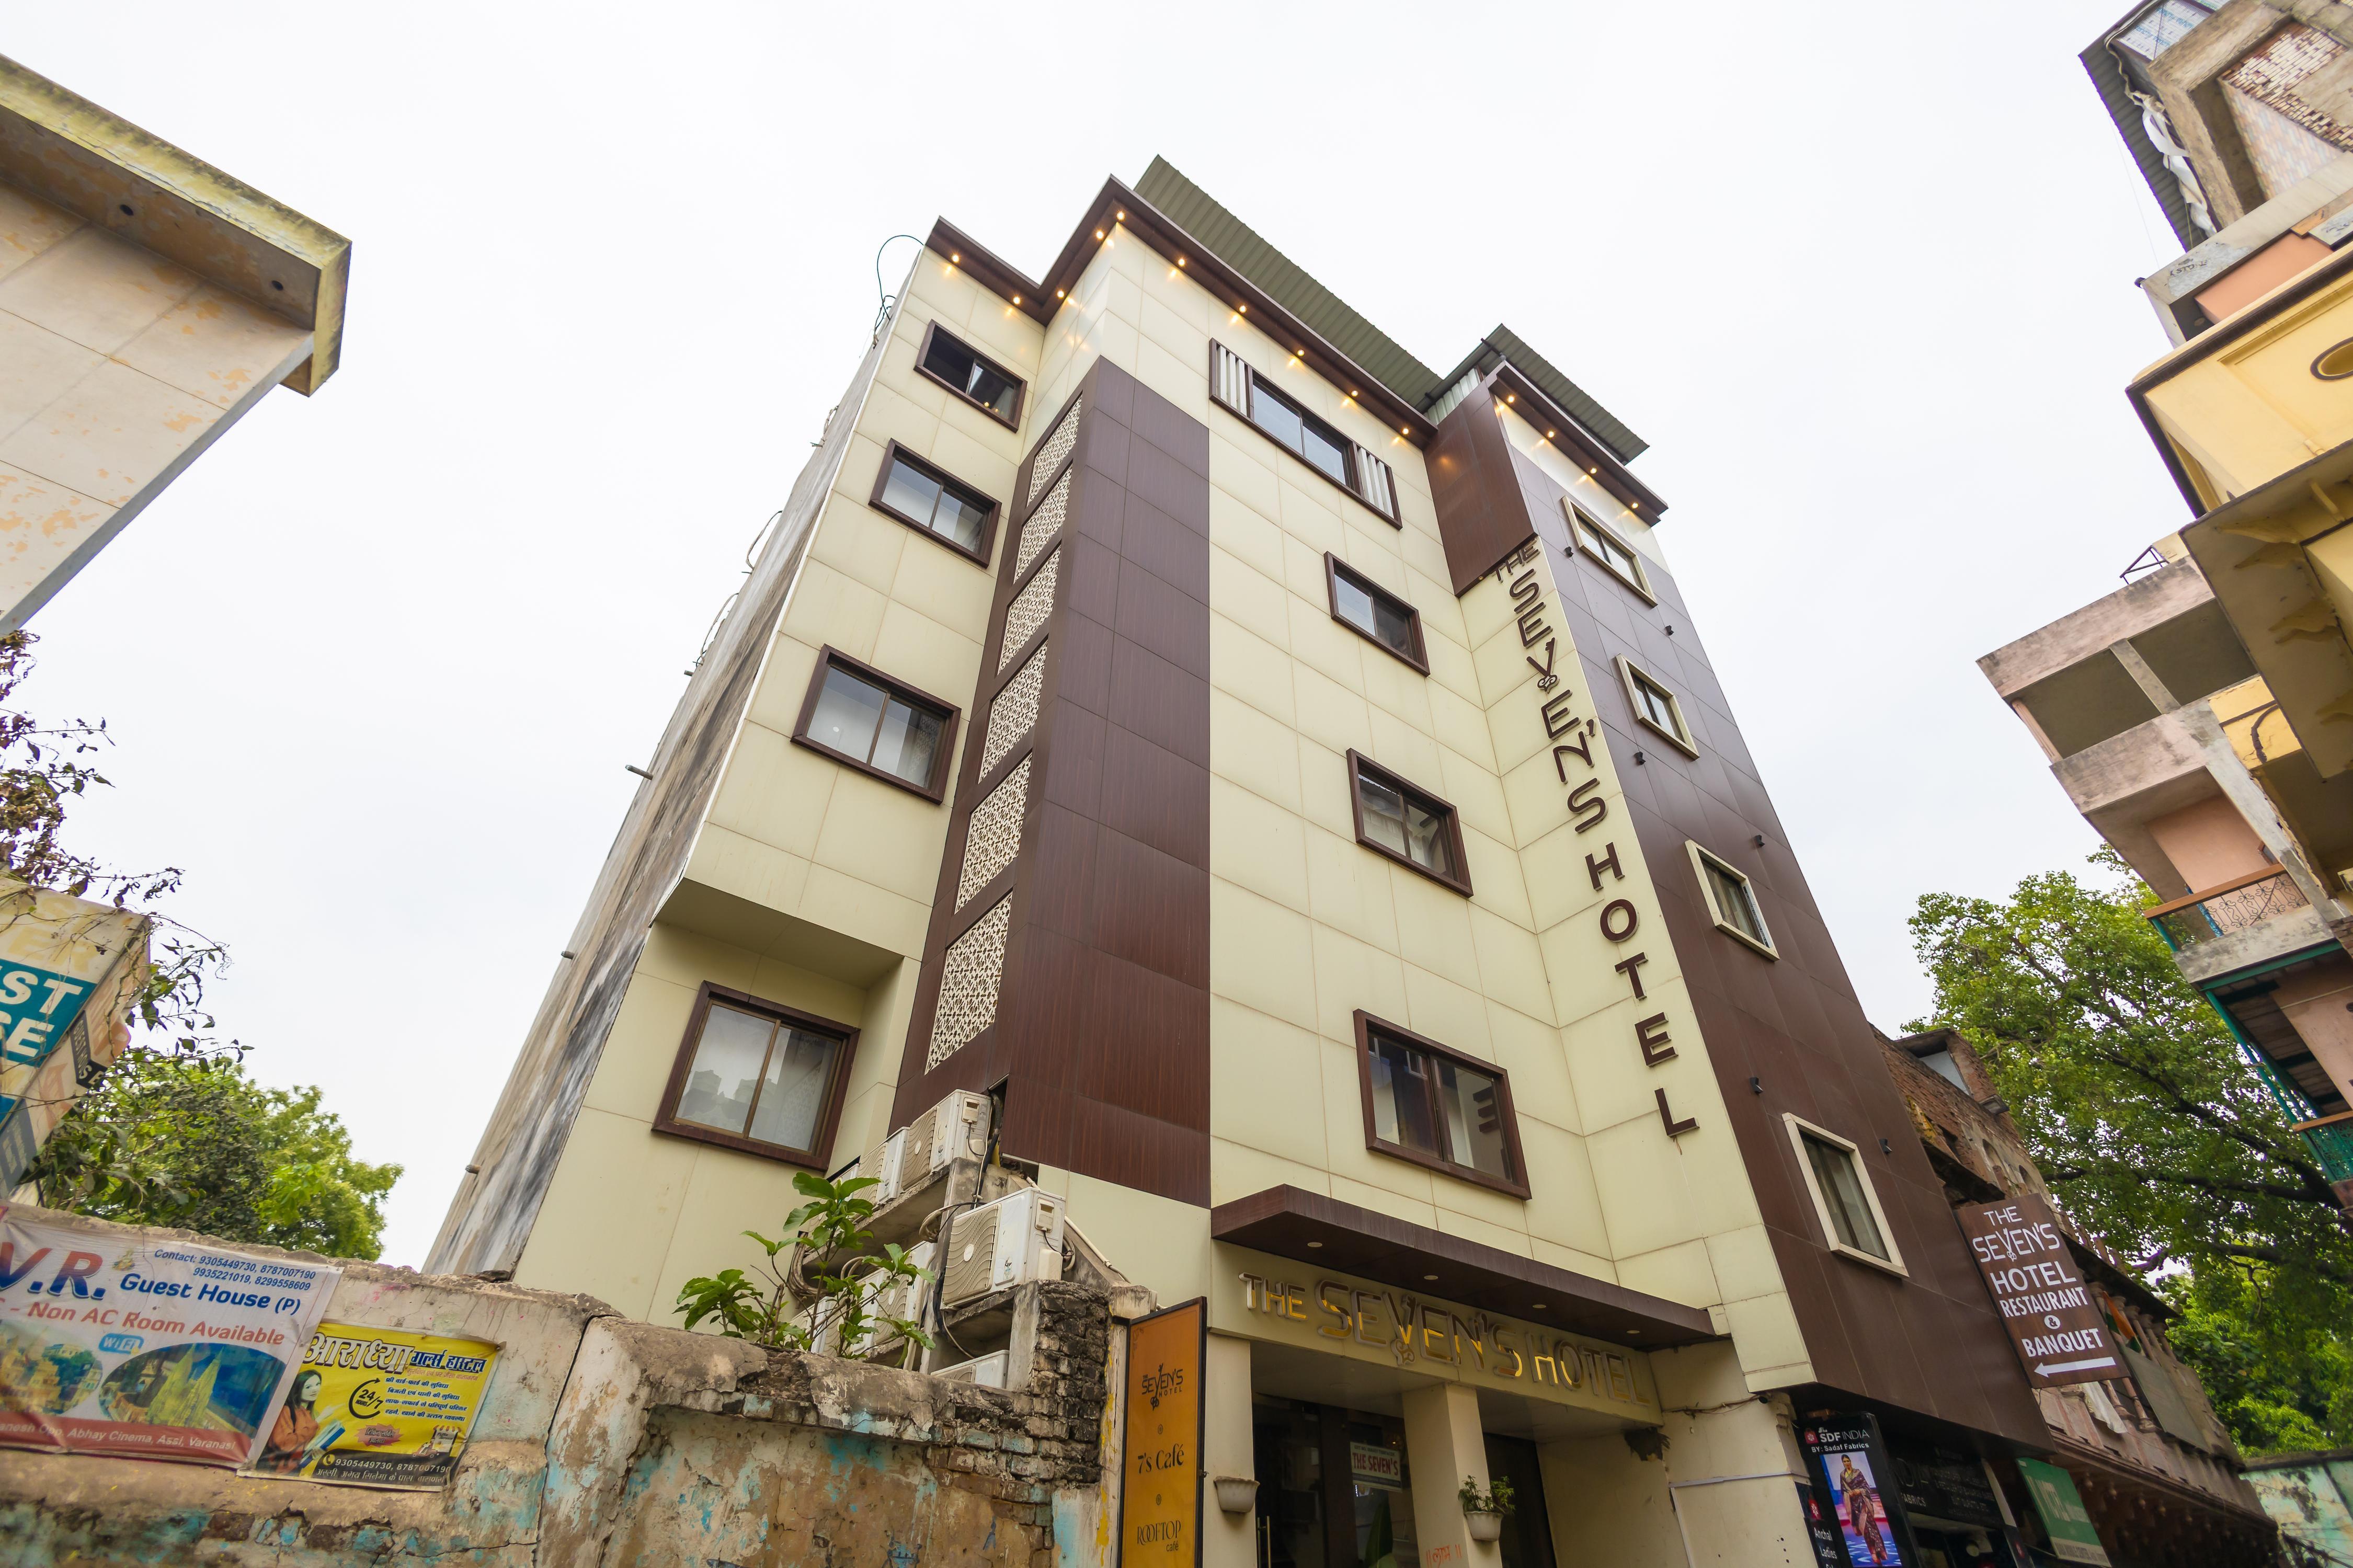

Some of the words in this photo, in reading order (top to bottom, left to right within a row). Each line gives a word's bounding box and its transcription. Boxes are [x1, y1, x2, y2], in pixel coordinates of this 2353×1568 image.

[1490, 536, 1540, 582] THE
[1509, 568, 1608, 834] SEVEN'S
[0, 970, 84, 1014] ST
[1585, 842, 1700, 1138] HOTEL
[1983, 1206, 2022, 1226] THE
[1972, 1221, 2060, 1263] SEVEN'S
[154, 1249, 197, 1264] Contact:
[199, 1255, 257, 1273] 9305449730,
[260, 1265, 316, 1280] 8787007190
[193, 1267, 252, 1285] 9935221019,
[255, 1276, 311, 1291] 8299558609
[1990, 1261, 2076, 1295] HOTEL
[120, 1273, 192, 1299] Guest
[198, 1284, 271, 1308] House
[275, 1297, 301, 1315] (P)
[1999, 1286, 2088, 1318] RESTAURANT
[28, 1301, 76, 1321] Non
[81, 1307, 119, 1325] AC
[122, 1311, 185, 1334] Room
[189, 1321, 285, 1345] Available
[302, 1332, 416, 1375] आराध्या
[1238, 1272, 1308, 1321] THE
[1315, 1278, 1523, 1378] SEVEN'S
[1526, 1332, 1652, 1406] HOTEL
[2021, 1327, 2103, 1358] BANQUET
[1142, 1364, 1183, 1401] SEVEN'S
[1159, 1386, 1182, 1398] HOTEL
[0, 1422, 35, 1433] anesh
[67, 1428, 107, 1441] Abhay
[109, 1430, 153, 1445] Cinema,
[157, 1434, 184, 1447] Assi,
[189, 1436, 236, 1450] Varanasi
[1820, 1432, 1841, 1443] SDF
[1842, 1429, 1870, 1440] INDIA
[335, 1458, 393, 1471] 9305449730,
[396, 1463, 451, 1473] 8787007190
[1137, 1446, 1152, 1474] 7's
[1156, 1443, 1185, 1469] Café
[1352, 1452, 1367, 1470] THE
[1368, 1455, 1399, 1476] SEVEN'S
[1137, 1520, 1182, 1547] ROOFTOP
[1166, 1540, 1180, 1553] café
[1814, 1527, 1833, 1541] Anchal
[1820, 1546, 1837, 1560] Ladies
